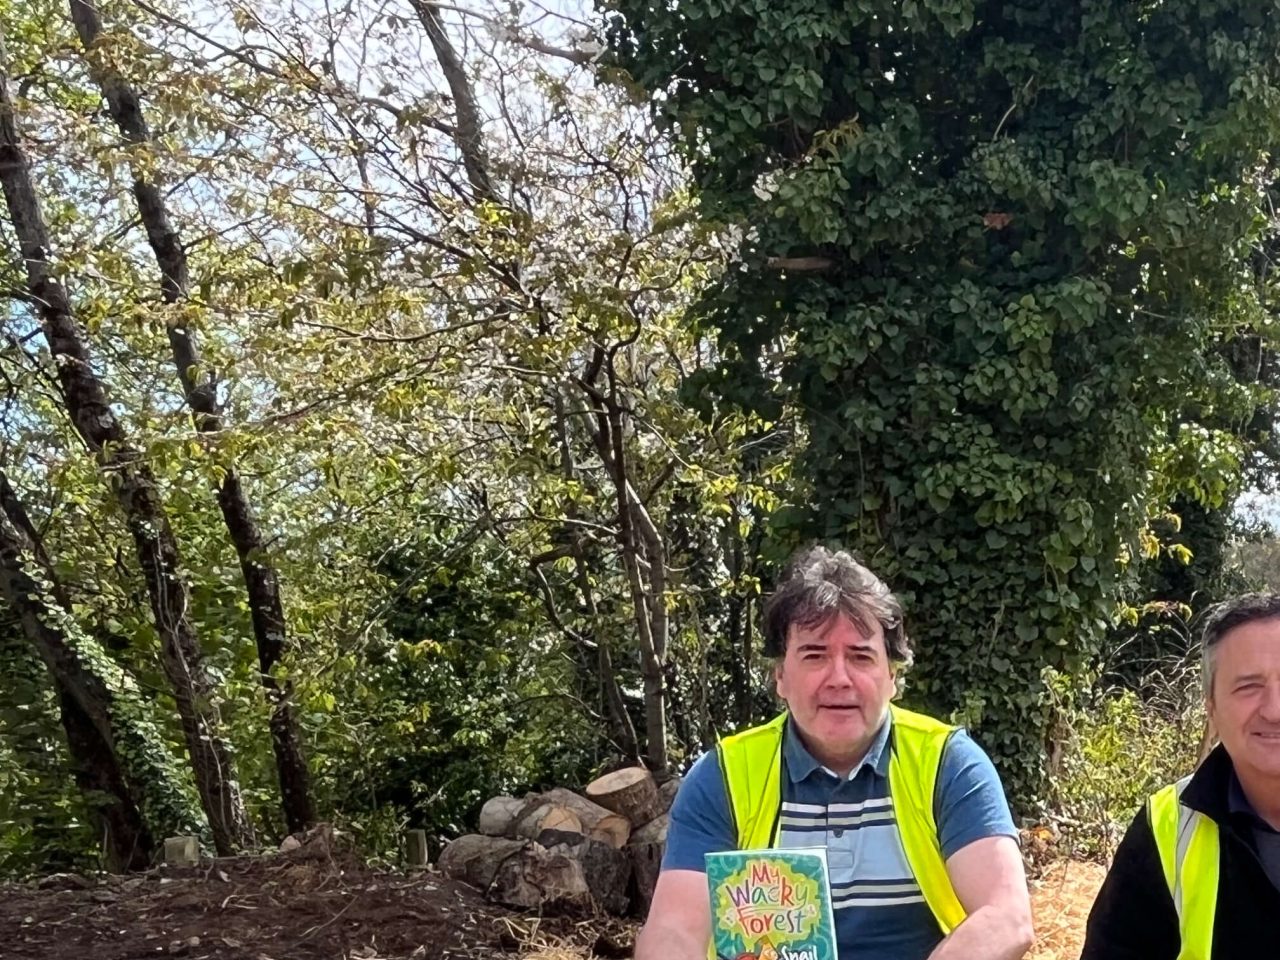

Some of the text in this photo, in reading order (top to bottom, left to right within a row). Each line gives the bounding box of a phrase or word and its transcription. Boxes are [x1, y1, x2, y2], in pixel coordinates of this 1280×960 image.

[752, 862, 780, 887] My
[726, 877, 808, 911] Wacky
[737, 908, 806, 936] Forest
